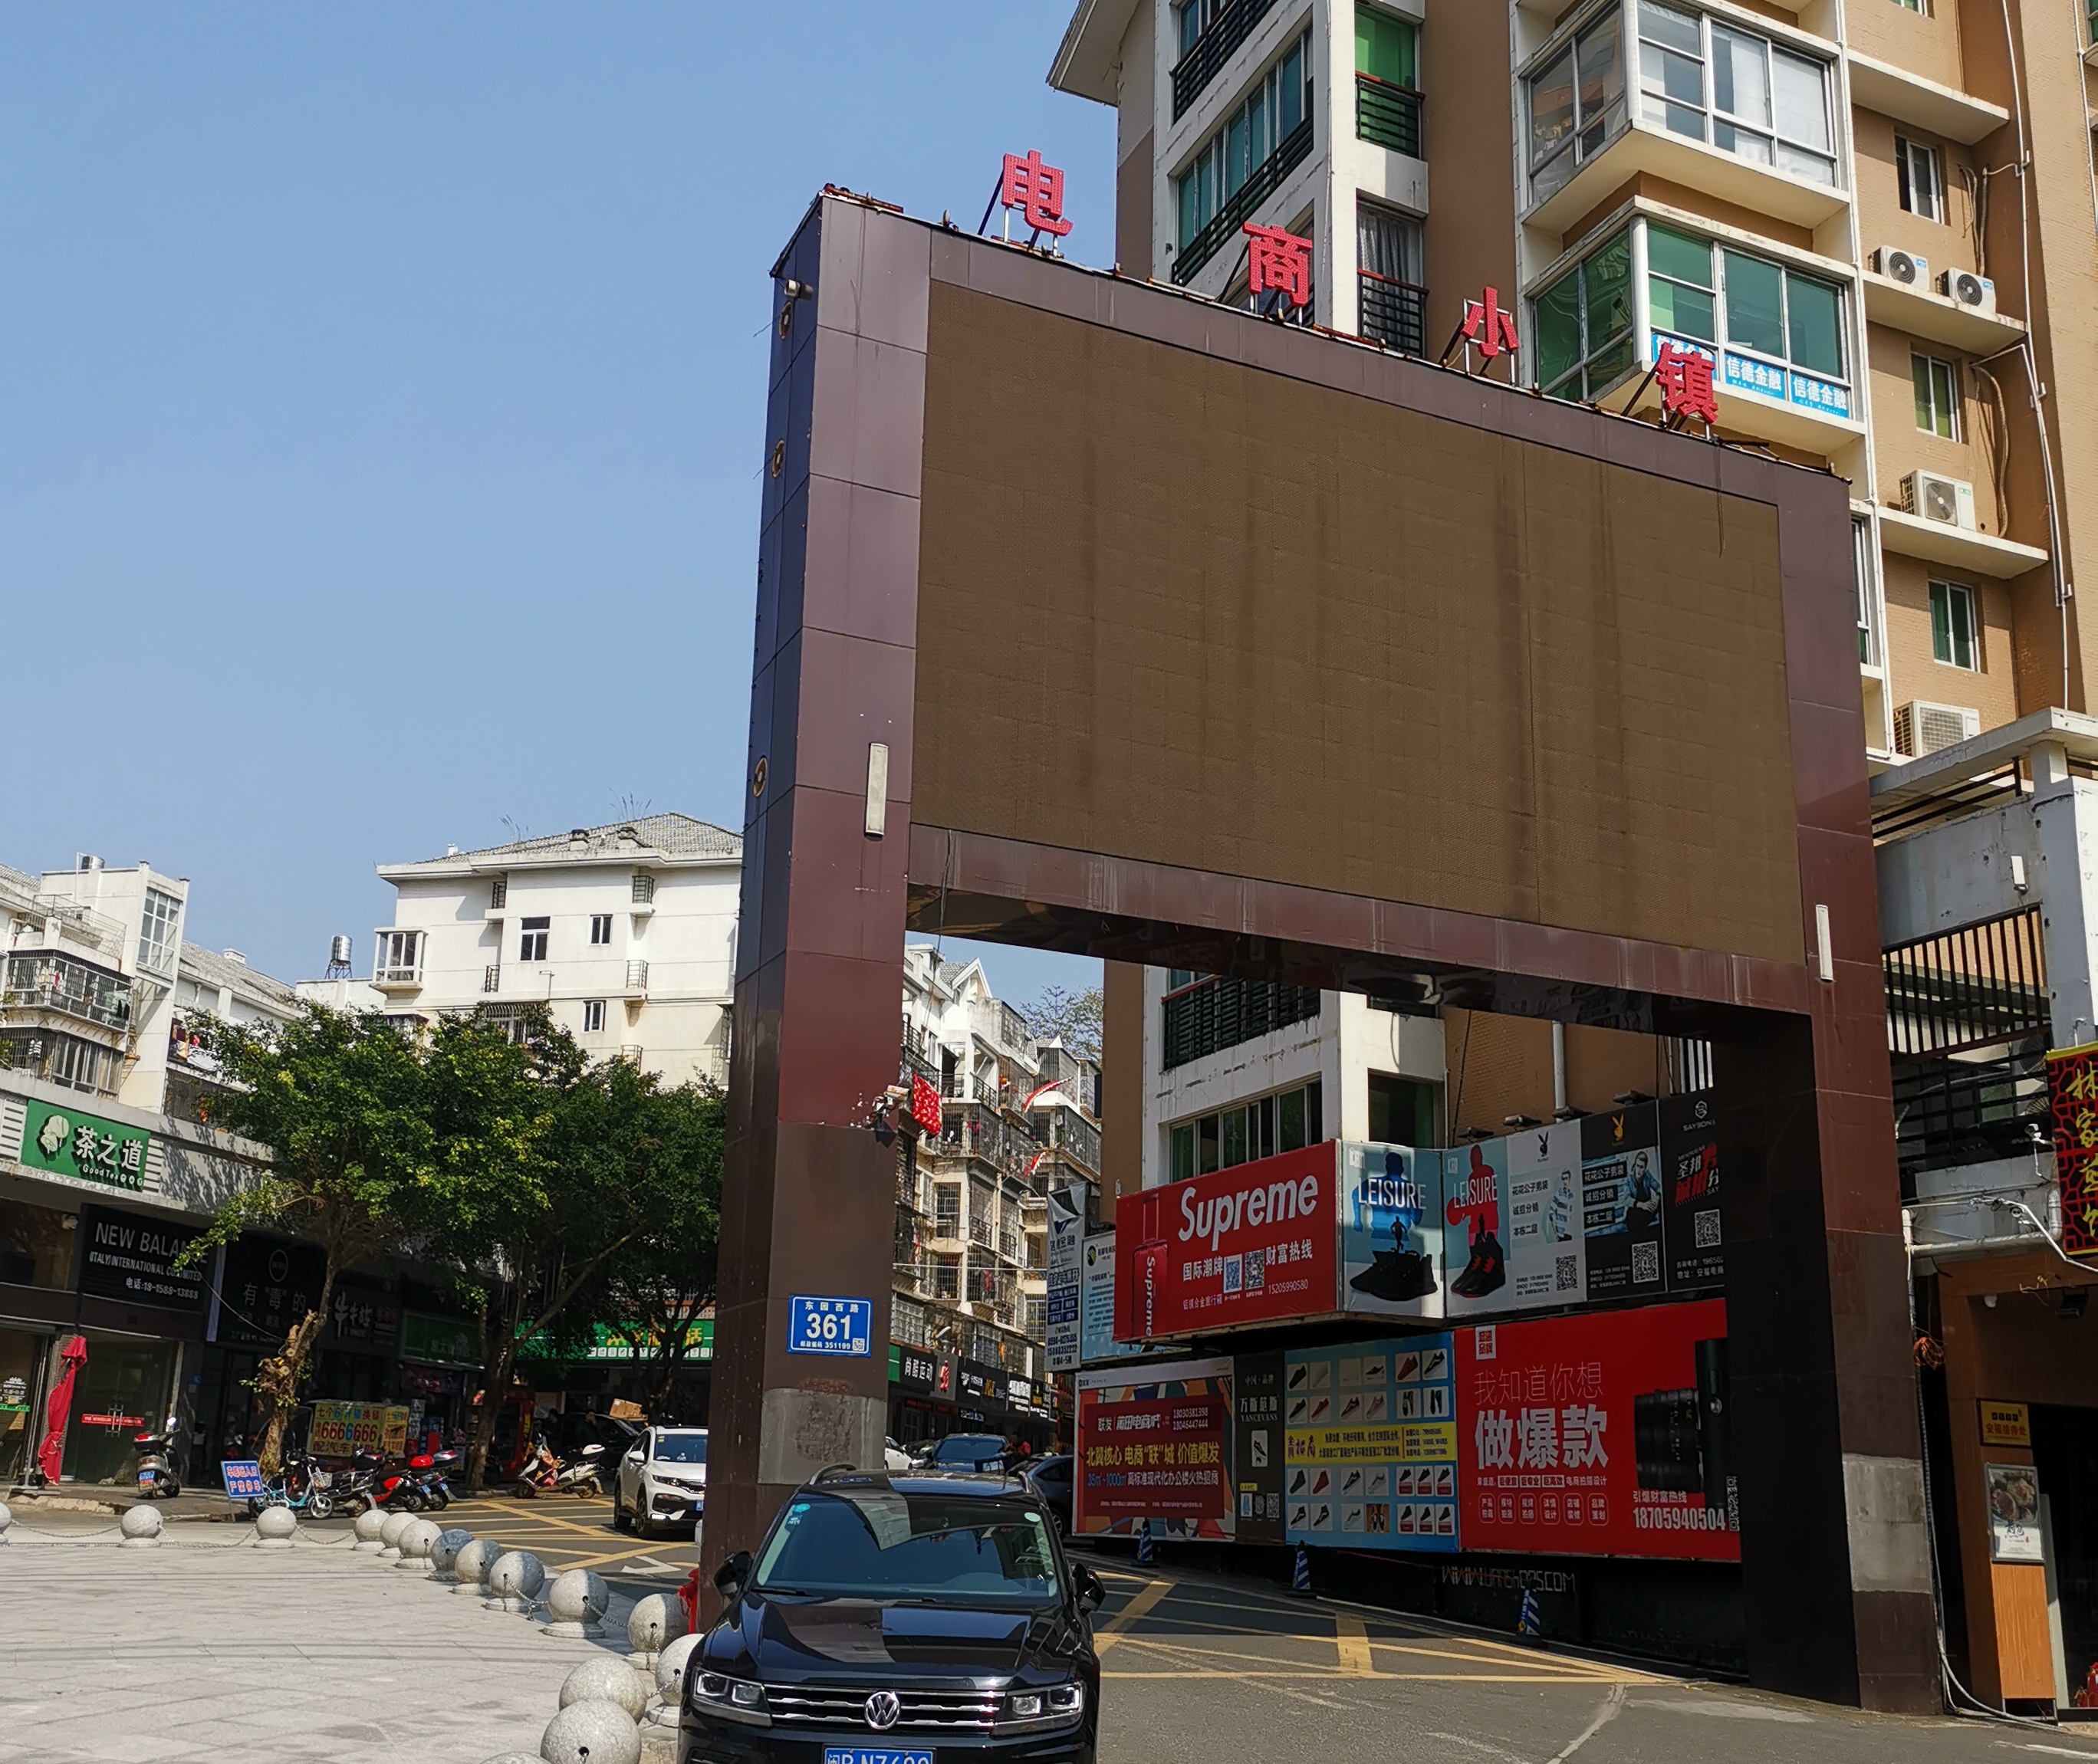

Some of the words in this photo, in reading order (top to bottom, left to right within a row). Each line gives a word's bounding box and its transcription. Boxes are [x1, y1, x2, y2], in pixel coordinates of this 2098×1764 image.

[1727, 356, 1781, 391] 信德金融
[1792, 376, 1847, 409] 信德金融
[77, 1125, 143, 1171] 茶之道
[1584, 1165, 1624, 1181] 花花公子男装
[1358, 1177, 1426, 1210] LEISURE
[1453, 1174, 1499, 1207] LEISURE
[1512, 1180, 1549, 1196] 花花公子男装
[1585, 1188, 1614, 1202] 诚招分销
[1178, 1175, 1318, 1251] Supreme
[1512, 1202, 1539, 1215] 诚招分销
[95, 1222, 136, 1249] NEW
[1182, 1257, 1224, 1282] 国际潮牌
[1265, 1240, 1313, 1266] 财富热线
[1144, 1256, 1156, 1337] Supreme
[1268, 1279, 1308, 1295] 15205990580
[805, 1301, 859, 1313] 东园西路
[806, 1313, 851, 1340] 361
[905, 1356, 933, 1381] 尚酷运动
[1474, 1361, 1604, 1406] 我知道你想
[321, 1421, 378, 1442] 6666666
[1097, 1417, 1112, 1432] 联发
[1475, 1404, 1610, 1470] 做爆款
[1177, 1440, 1221, 1465] 价值爆发
[1295, 1434, 1316, 1457] 招商
[1633, 1490, 1688, 1503] 引爆财富热线
[1633, 1507, 1725, 1530] 18705940504
